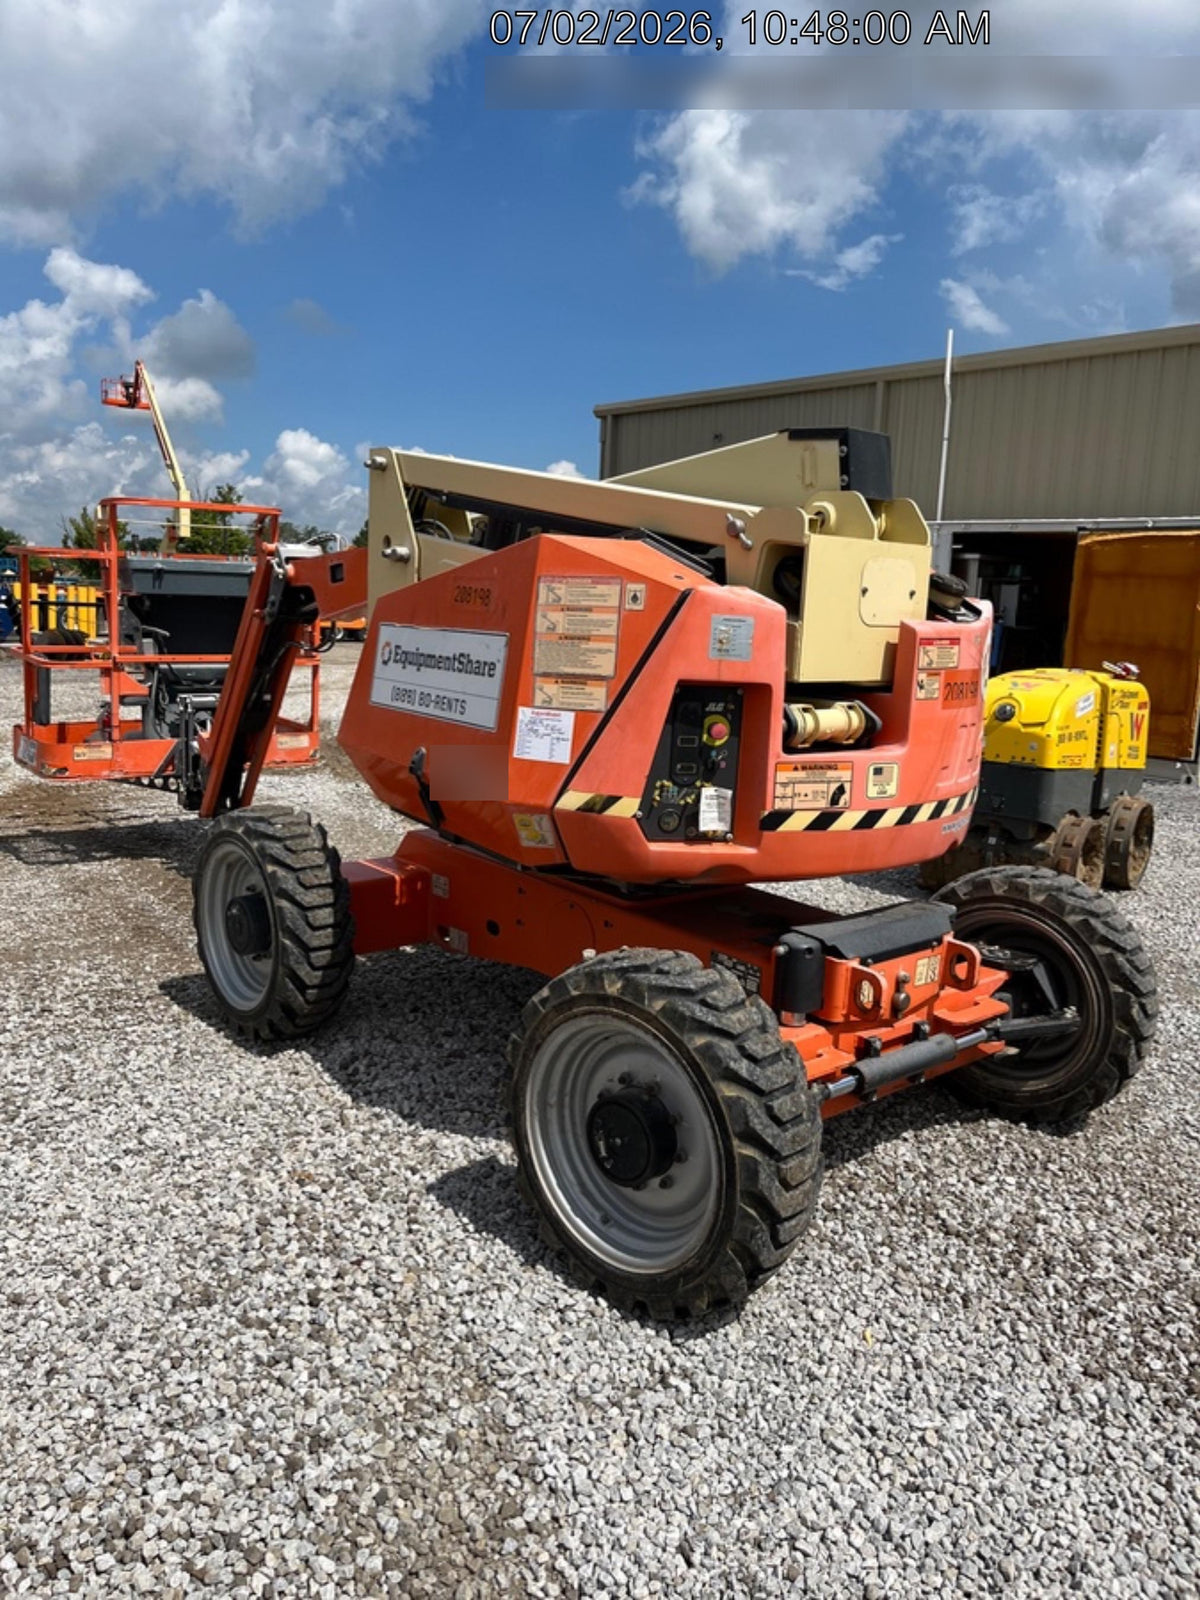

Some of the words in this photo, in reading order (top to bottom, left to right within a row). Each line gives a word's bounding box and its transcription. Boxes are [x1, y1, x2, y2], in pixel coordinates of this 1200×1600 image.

[454, 585, 492, 606] 208198
[393, 645, 497, 678] EquipmentShare
[801, 763, 838, 771] WARNING
